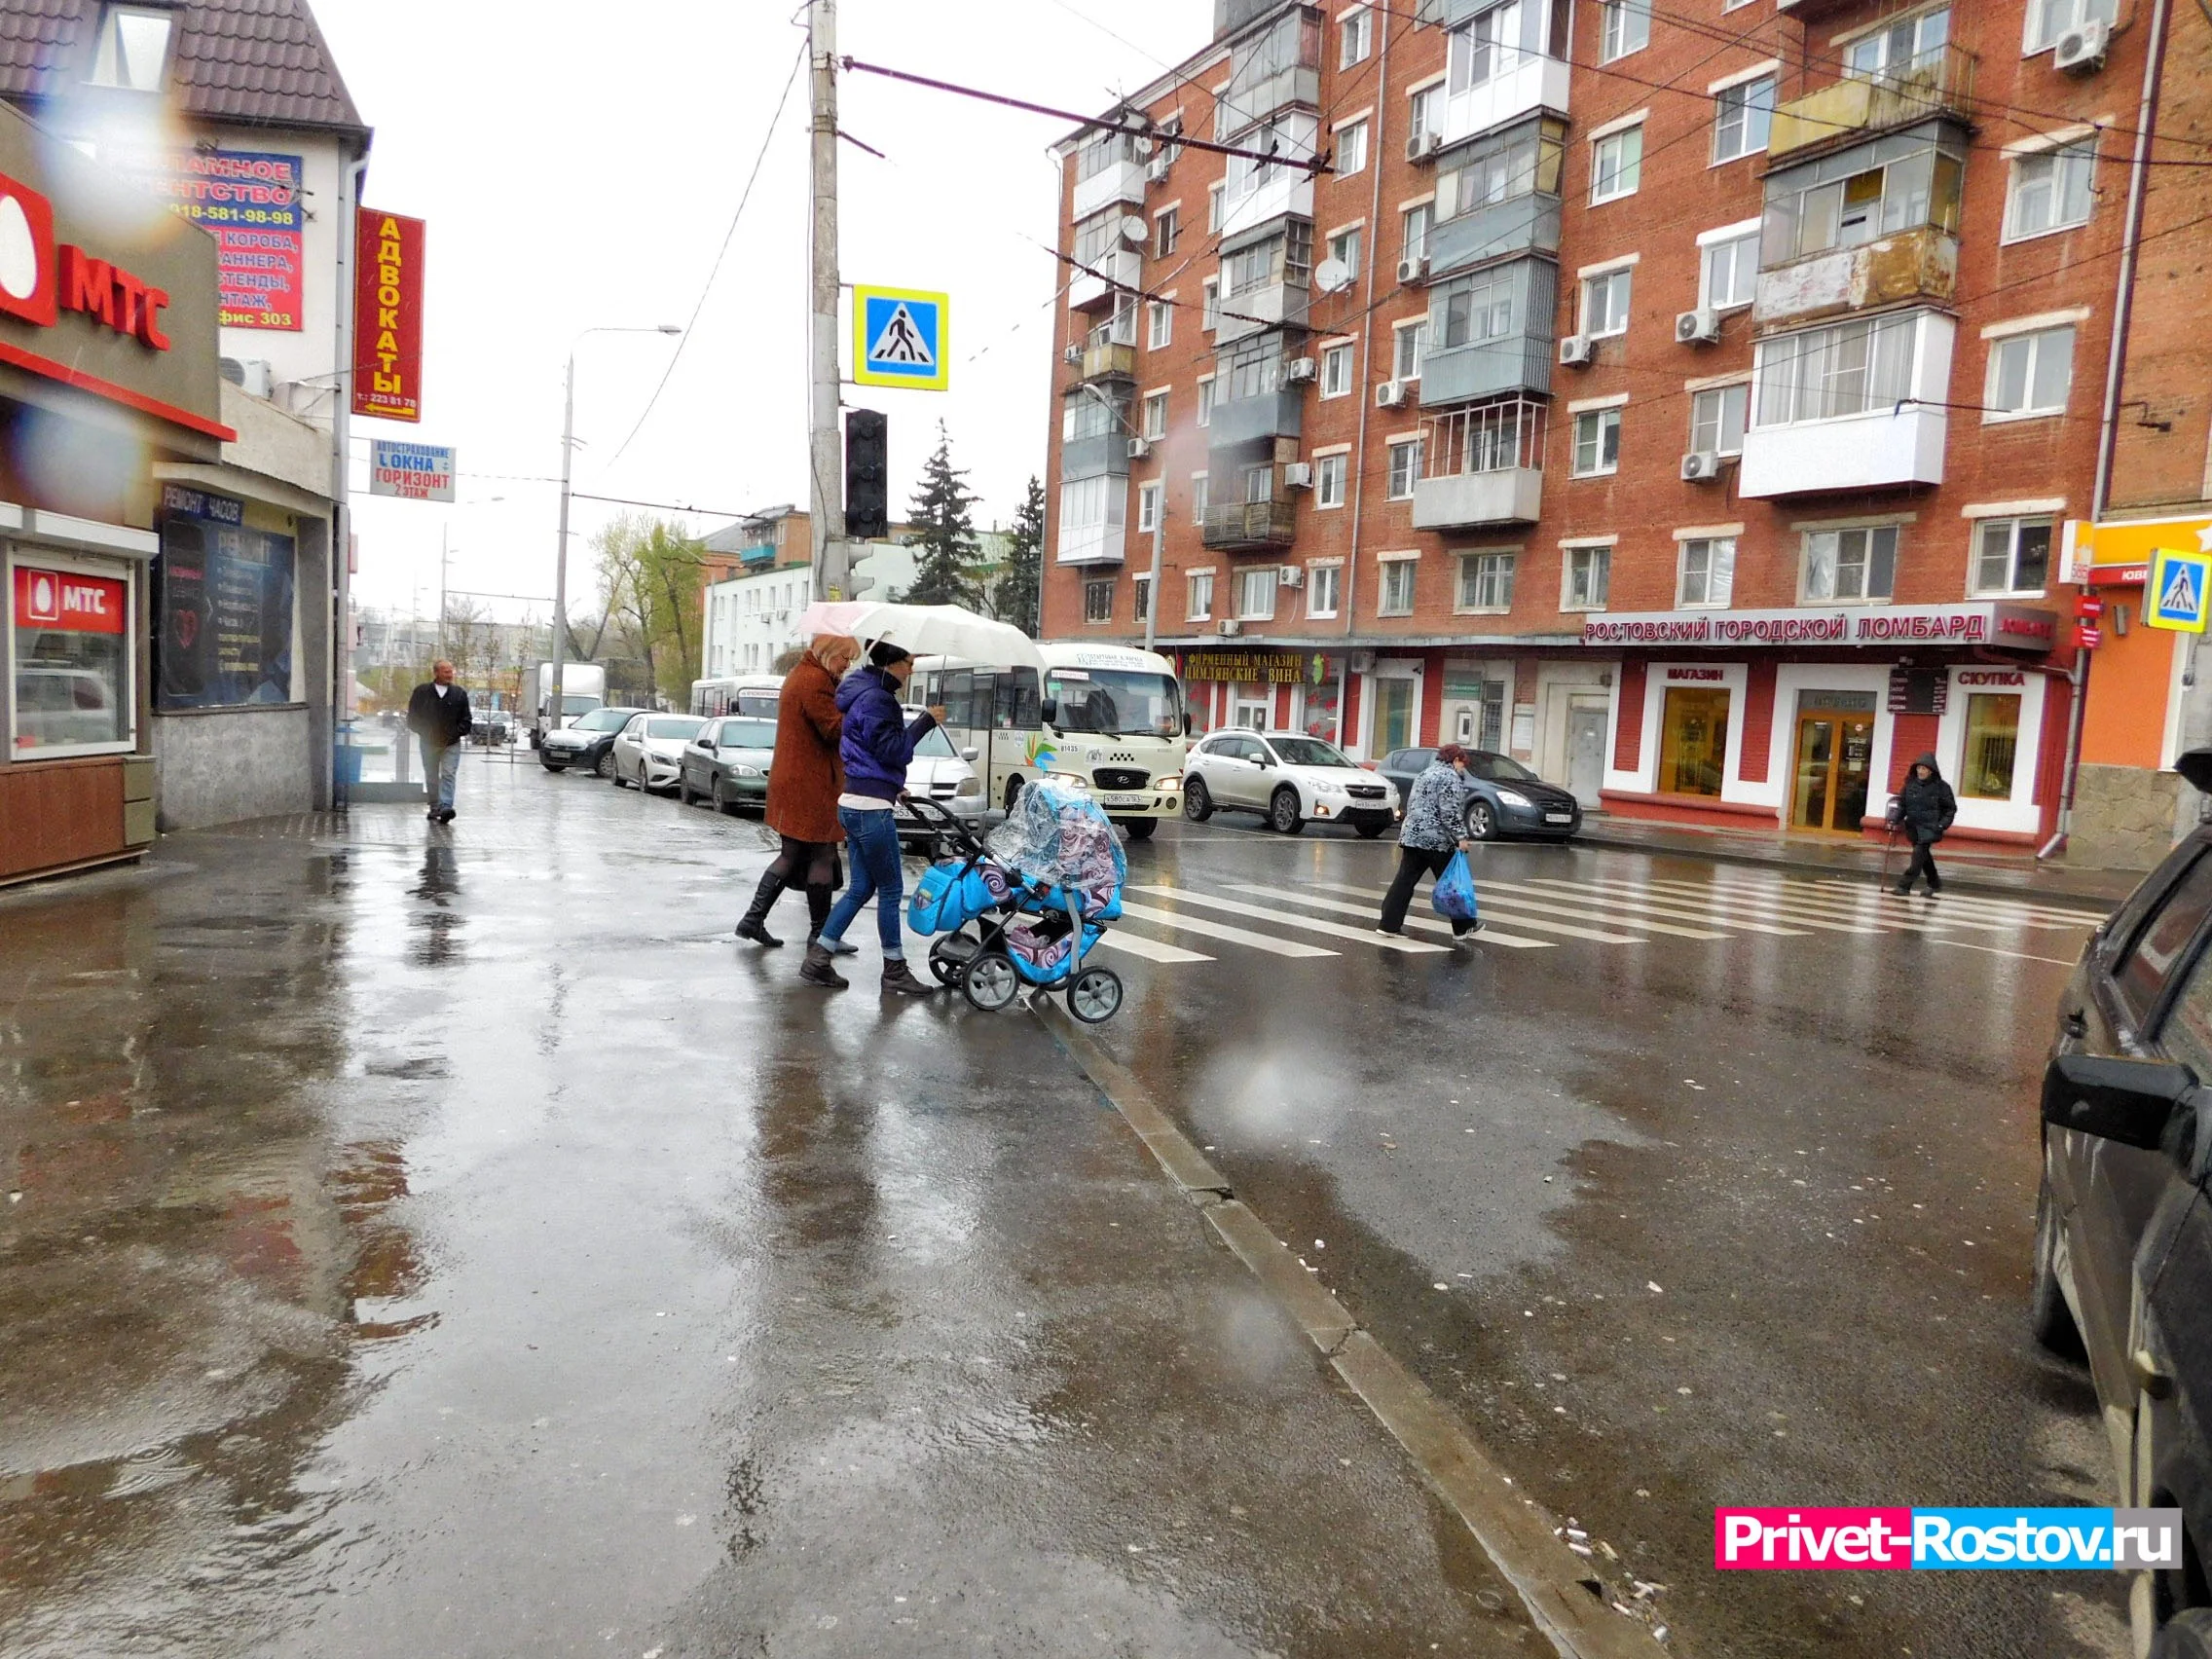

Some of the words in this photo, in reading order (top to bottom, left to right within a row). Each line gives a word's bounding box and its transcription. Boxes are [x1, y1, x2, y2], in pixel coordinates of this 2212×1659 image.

[218, 252, 294, 273] АННЕРА,
[58, 244, 169, 351] МТС
[218, 292, 272, 311] НТАЖ,
[373, 216, 402, 394] АДВОКАТЫ
[219, 310, 255, 326] фис
[260, 313, 292, 326] 303
[370, 392, 389, 405] 223
[390, 454, 435, 473] ОКНА
[375, 467, 451, 490] ГОРИЗОНТ
[402, 486, 429, 498] ЭТАЖ
[164, 486, 203, 514] РЕМОНТ
[208, 497, 240, 522] ЧАСОВ
[63, 584, 107, 615] МТС
[1585, 616, 1711, 643] РОСТОВСКИЙ
[1714, 613, 1847, 644] ГОРОДСКОЙ
[1857, 614, 1987, 642] ЛОМБАРД
[1188, 652, 1249, 666] ФИРМЕННЫЙ
[1253, 653, 1303, 667] МАГАЗИН
[1185, 666, 1259, 682] ЦИМЛЯНСКИЕ
[1269, 668, 1301, 682] ВИНА
[1668, 668, 1723, 682] МАГАЗИН
[1958, 671, 2026, 686] СКУПКА
